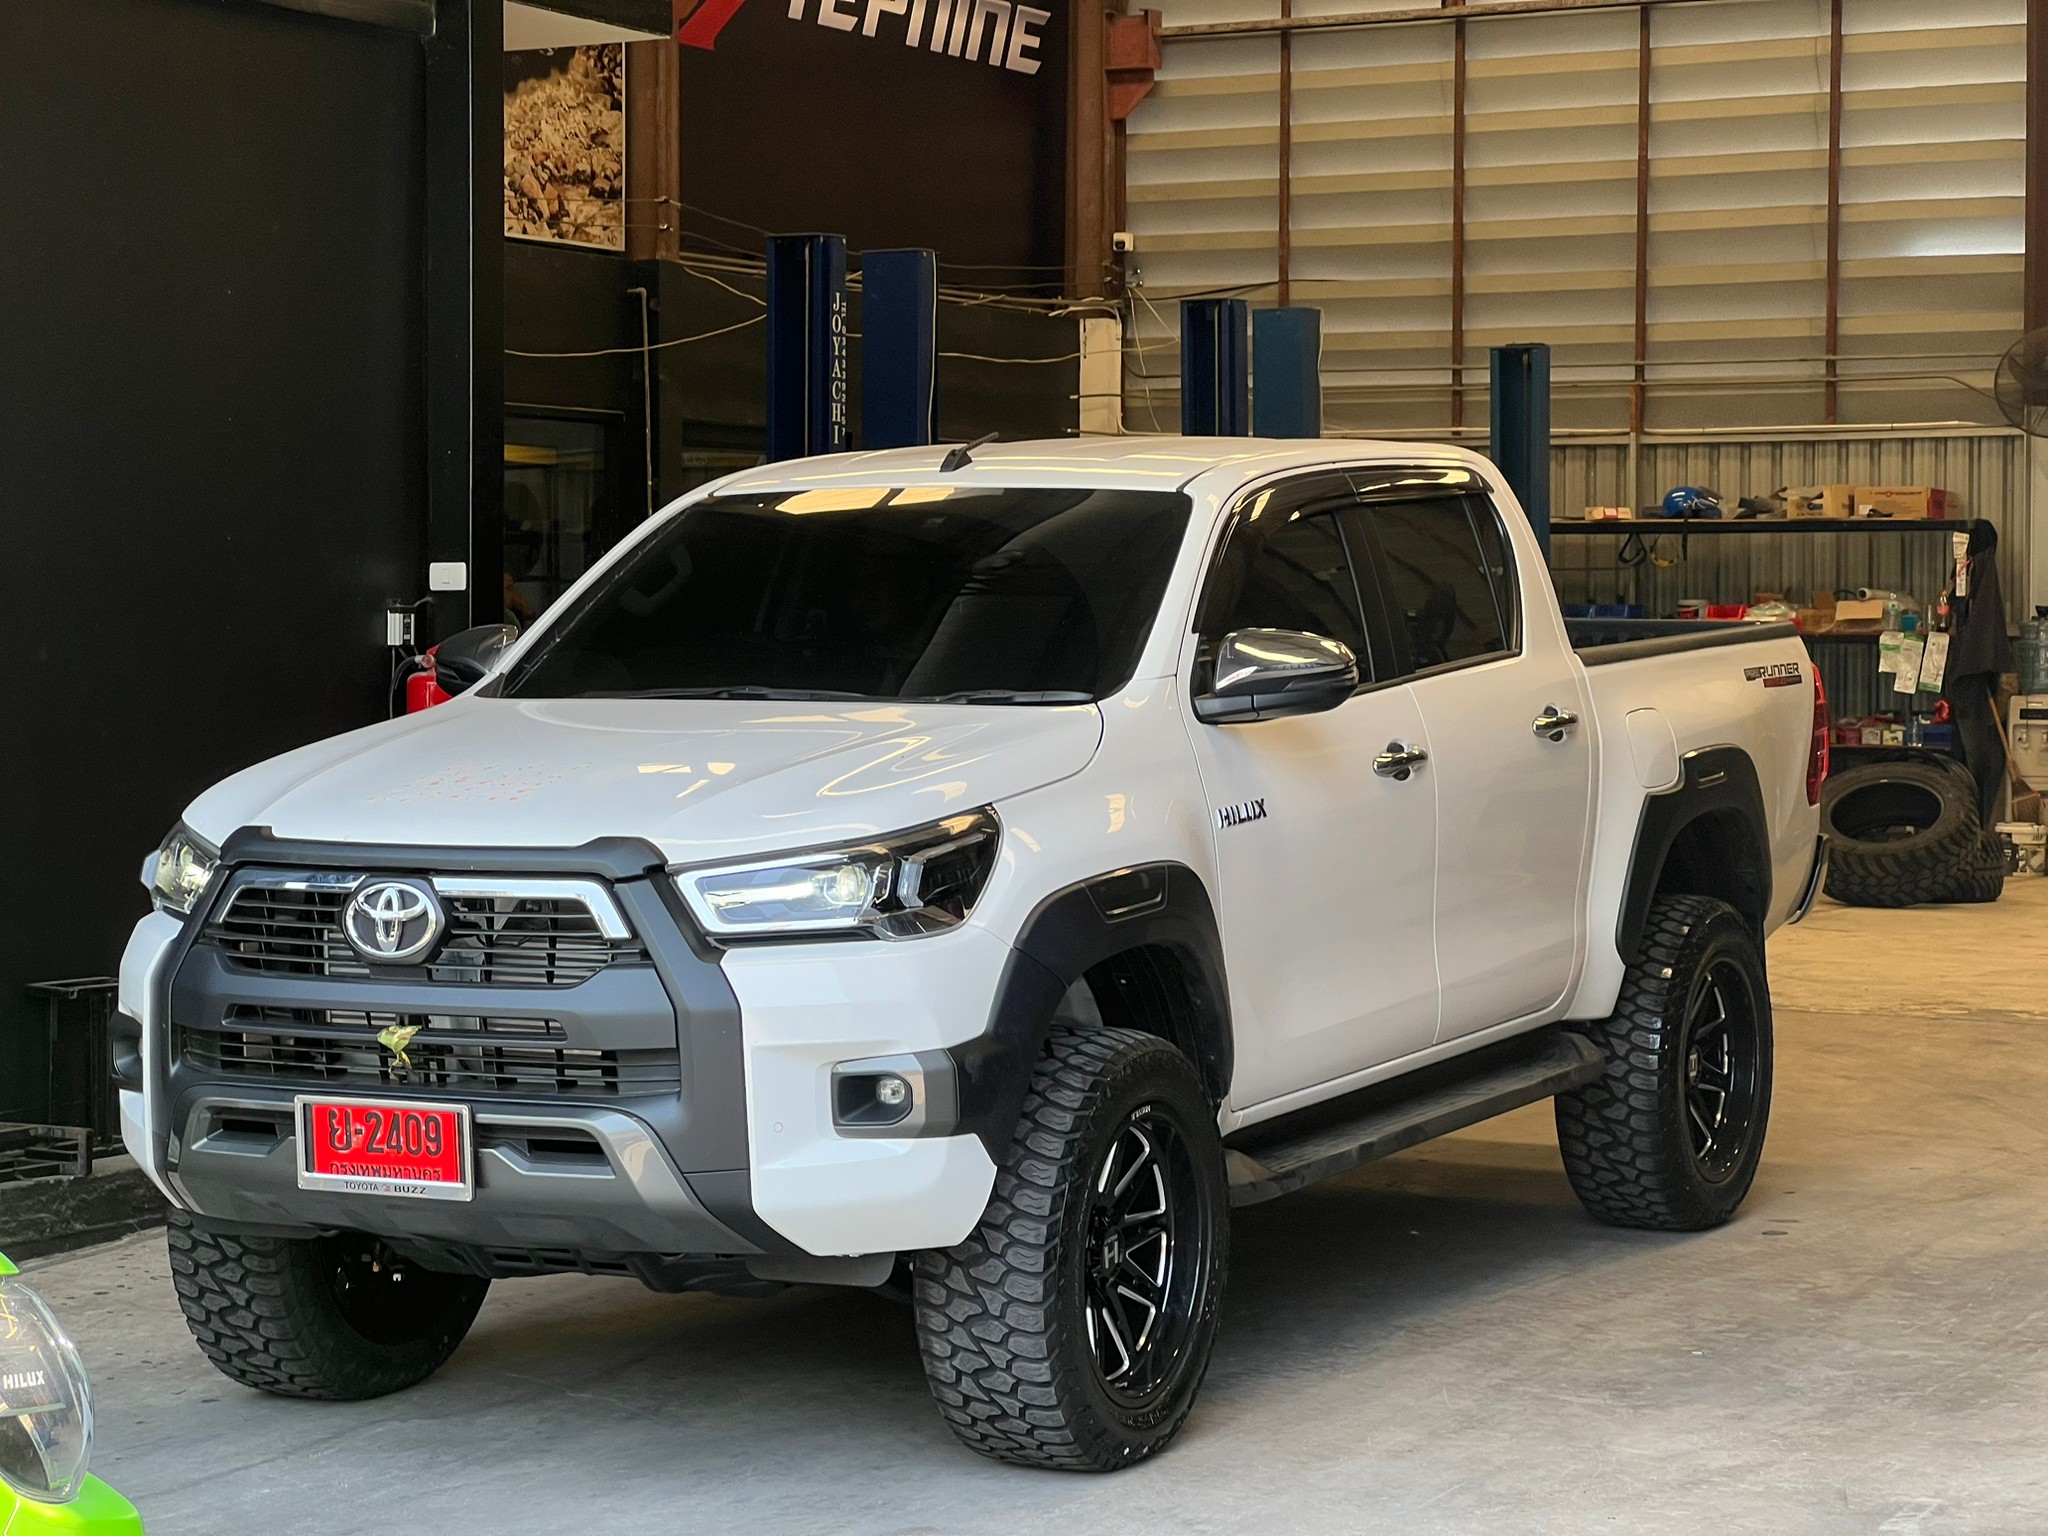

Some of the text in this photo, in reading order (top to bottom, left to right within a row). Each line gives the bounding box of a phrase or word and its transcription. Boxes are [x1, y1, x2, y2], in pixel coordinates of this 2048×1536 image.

[832, 292, 841, 444] JOYACHI
[1216, 798, 1267, 829] HILUX
[330, 1163, 441, 1181] กรงเทพมหานคร
[344, 1181, 427, 1195] TOYOTA BUZZ
[3, 1370, 45, 1389] HILUX
